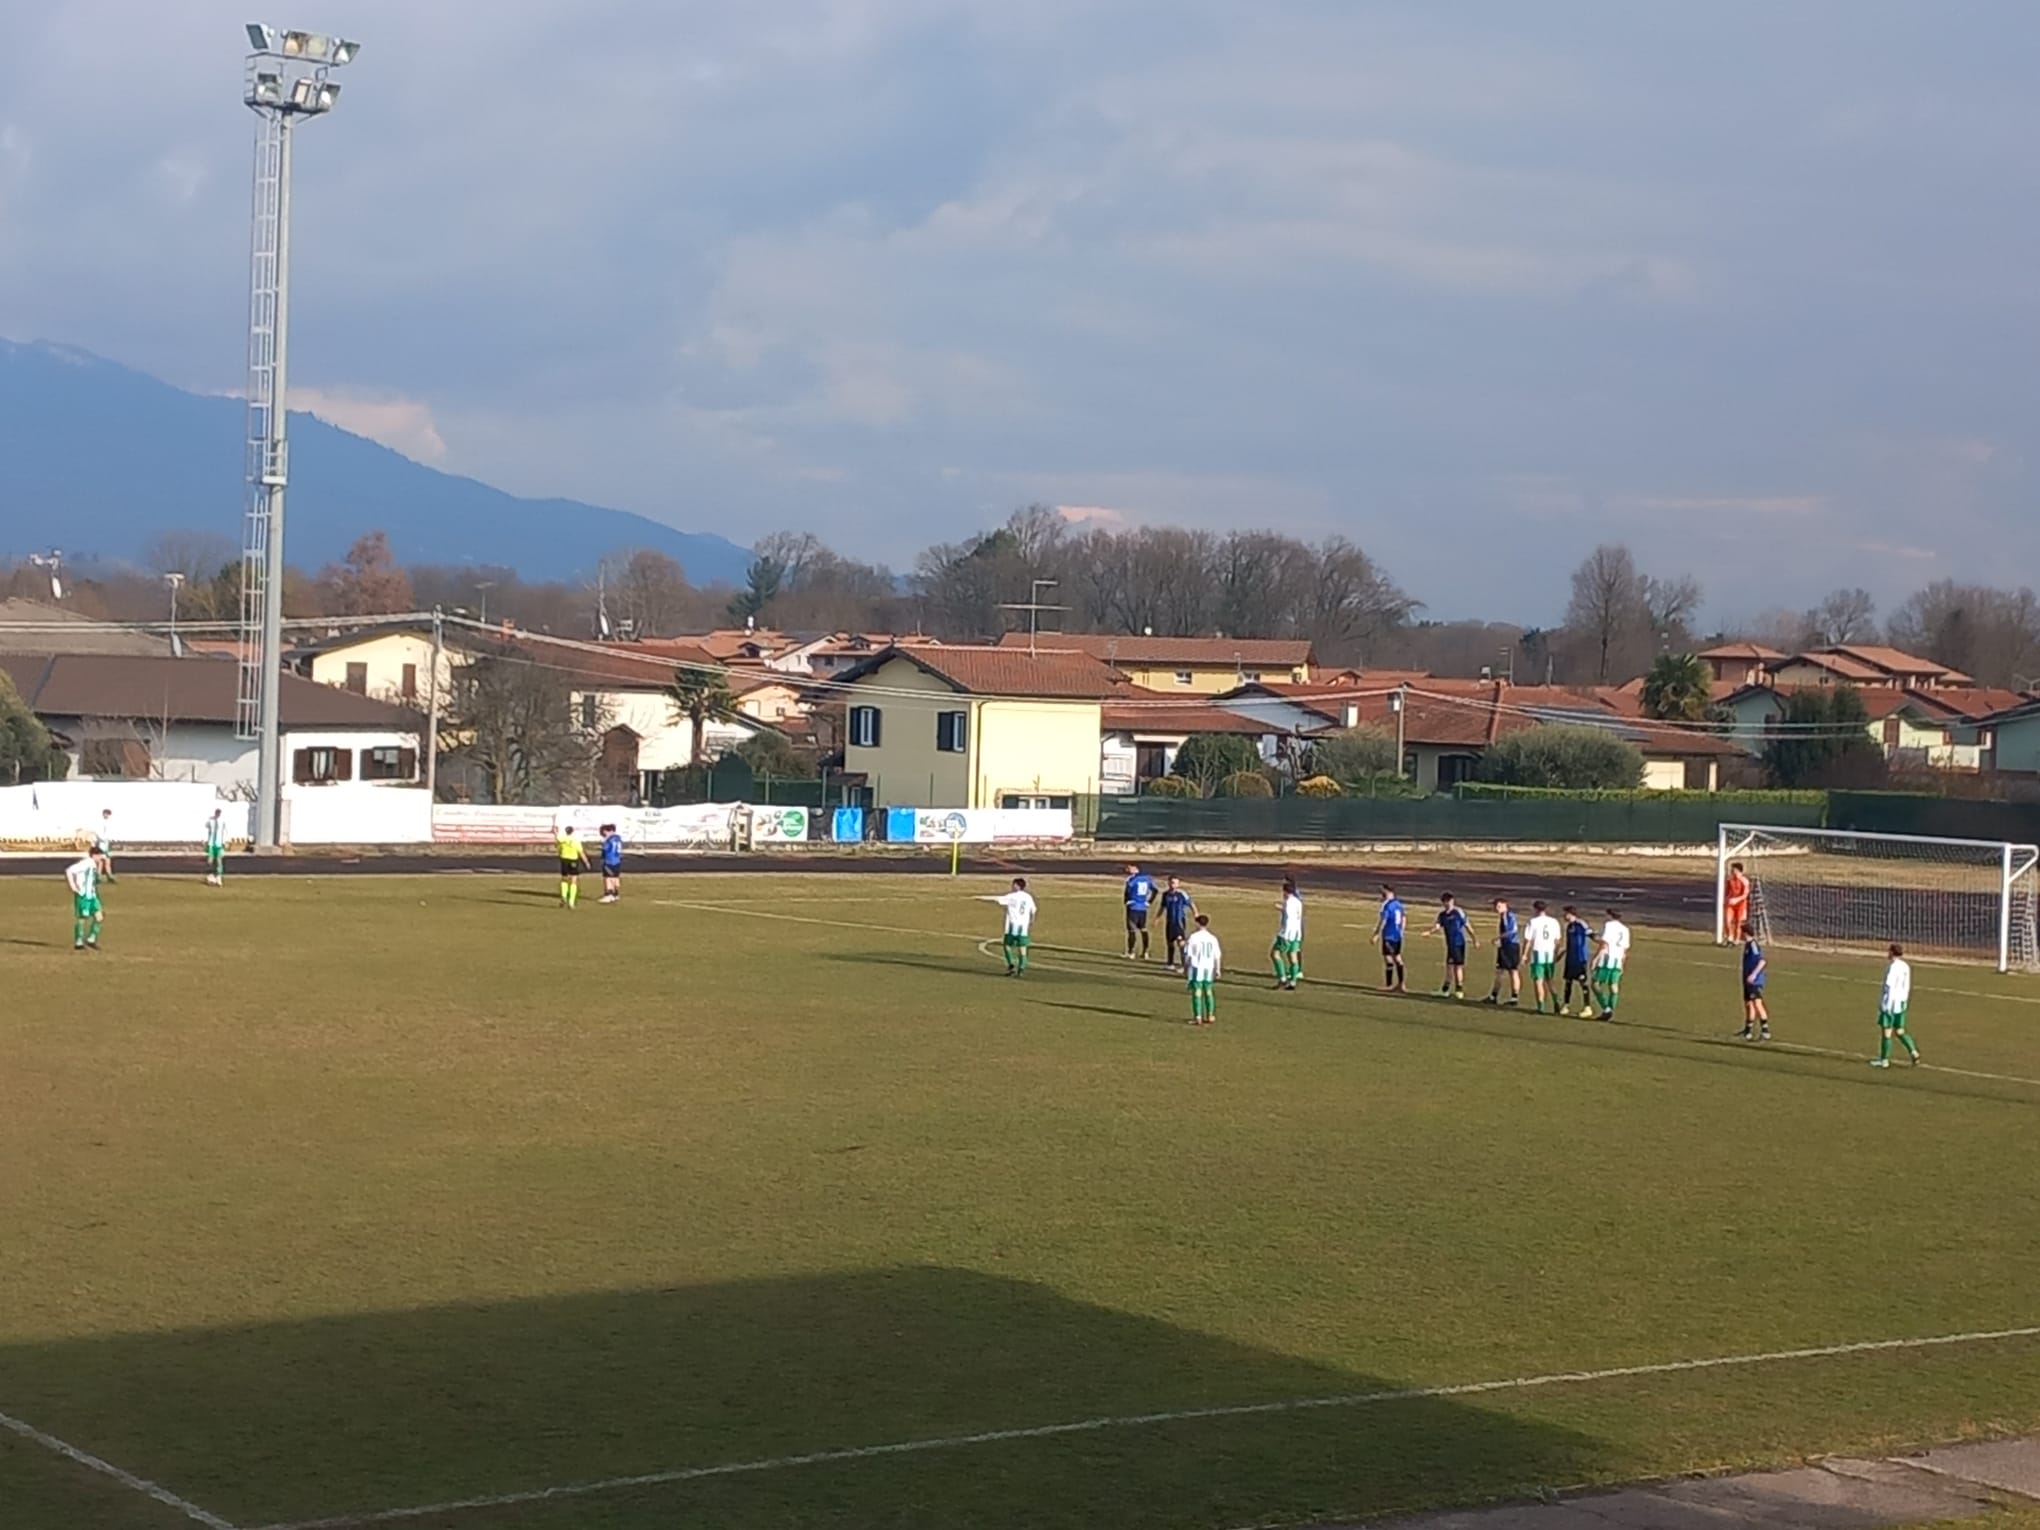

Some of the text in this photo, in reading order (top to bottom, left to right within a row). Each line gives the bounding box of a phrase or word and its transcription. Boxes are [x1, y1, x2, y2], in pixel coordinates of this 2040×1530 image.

[1542, 924, 1550, 940] 6
[1616, 931, 1624, 947] 2
[1200, 941, 1213, 958] 10
